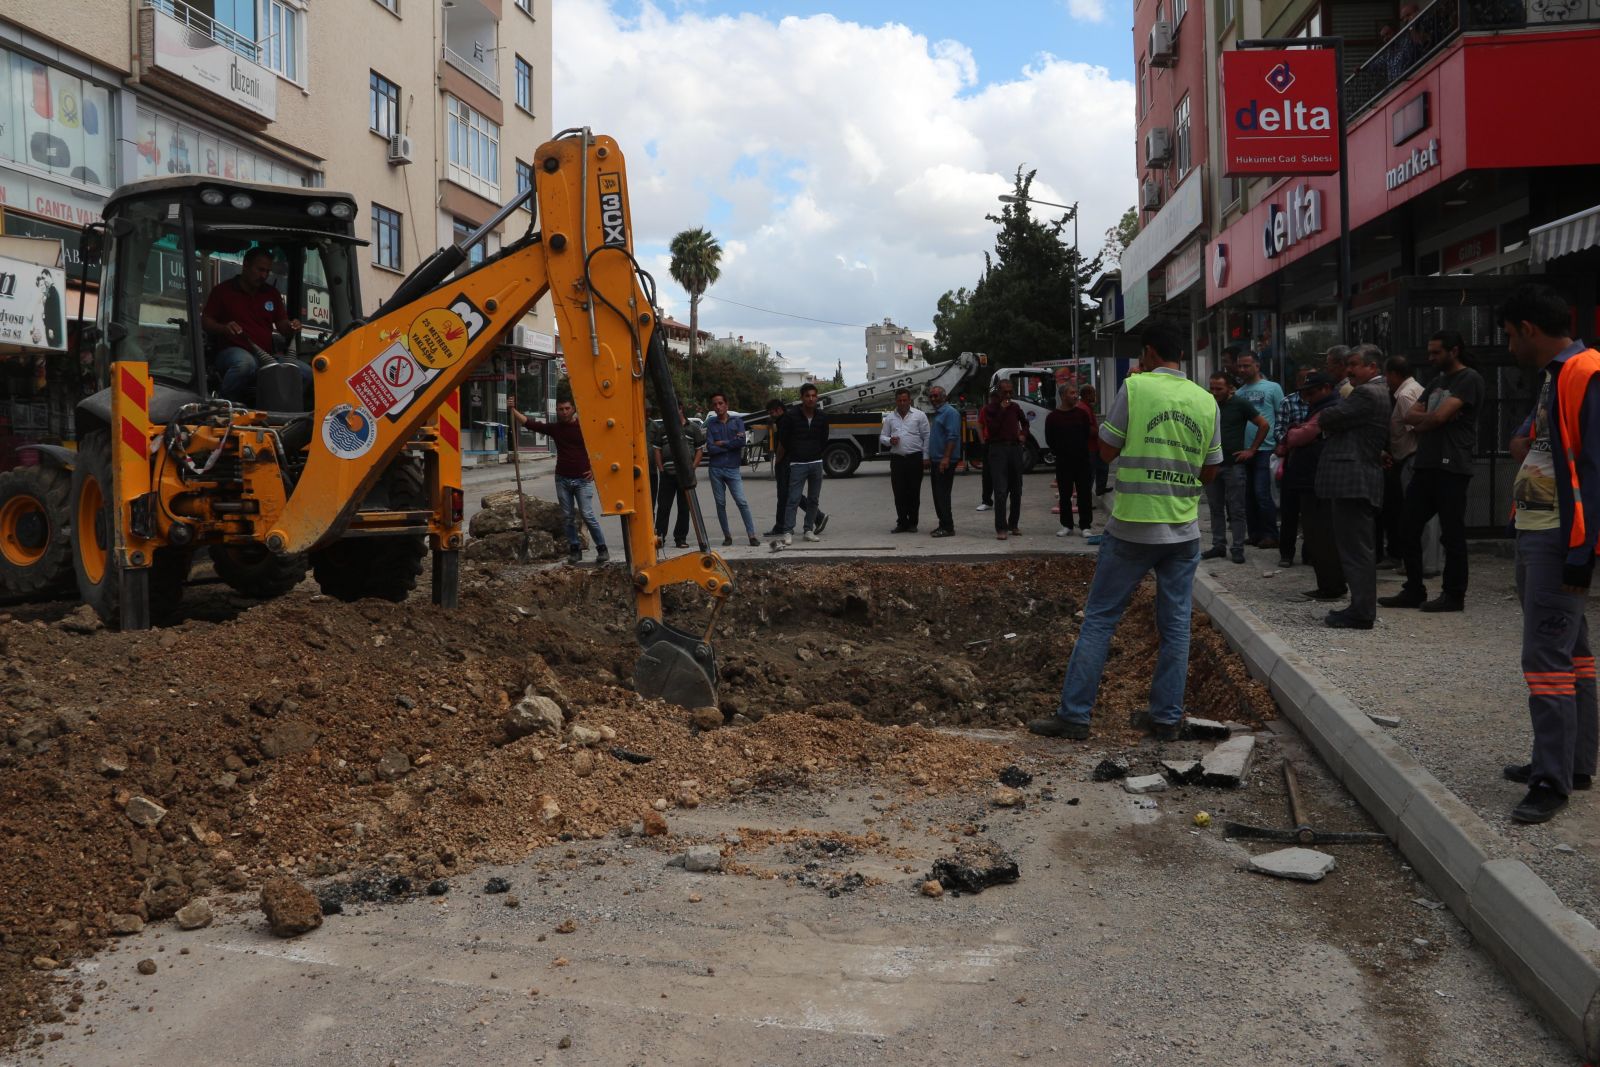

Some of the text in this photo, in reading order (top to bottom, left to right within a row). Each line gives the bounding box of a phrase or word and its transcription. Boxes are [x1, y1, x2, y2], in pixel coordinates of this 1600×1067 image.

[1235, 99, 1331, 131] delta
[1386, 138, 1441, 192] market
[602, 194, 625, 243] 3CX
[1263, 183, 1322, 259] delta
[308, 293, 321, 305] ulu
[313, 306, 329, 319] CAN
[422, 318, 453, 359] 25 METREDEN
[422, 335, 438, 354] FAZLA
